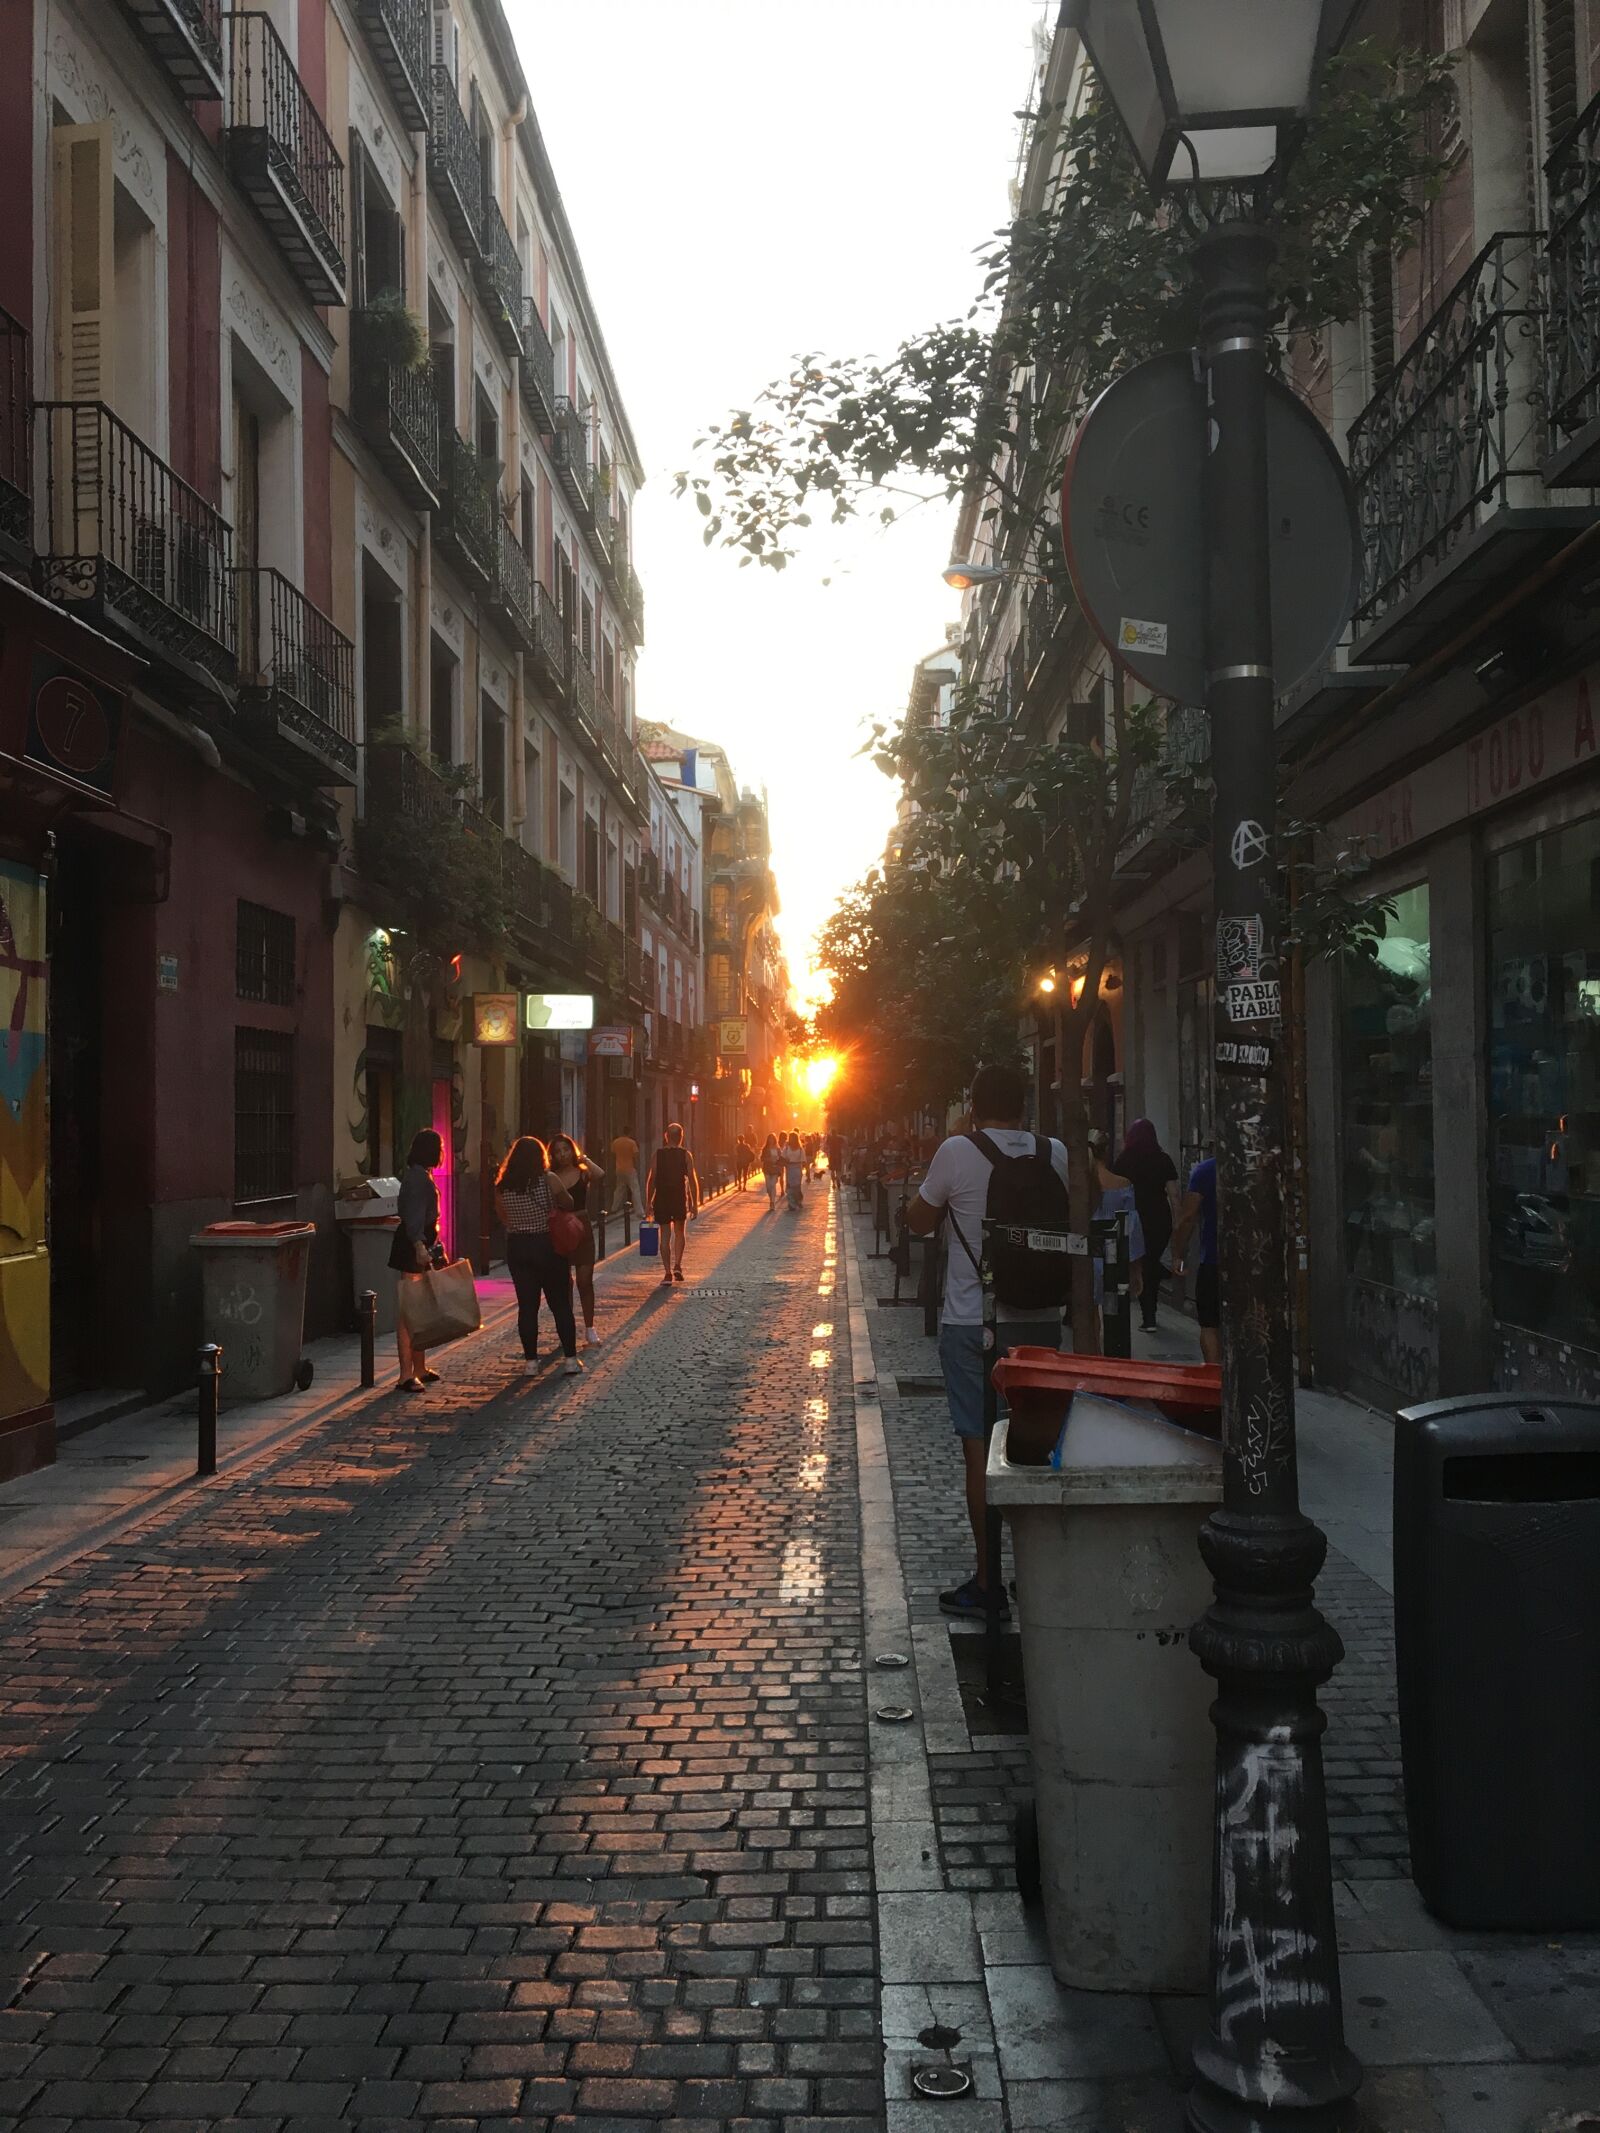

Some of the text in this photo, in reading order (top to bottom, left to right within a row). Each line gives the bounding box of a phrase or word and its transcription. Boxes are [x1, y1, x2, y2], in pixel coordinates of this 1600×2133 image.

[64, 692, 87, 752] 7
[1469, 705, 1545, 807] TODO
[1574, 676, 1596, 759] A
[1230, 983, 1280, 1003] PABLO
